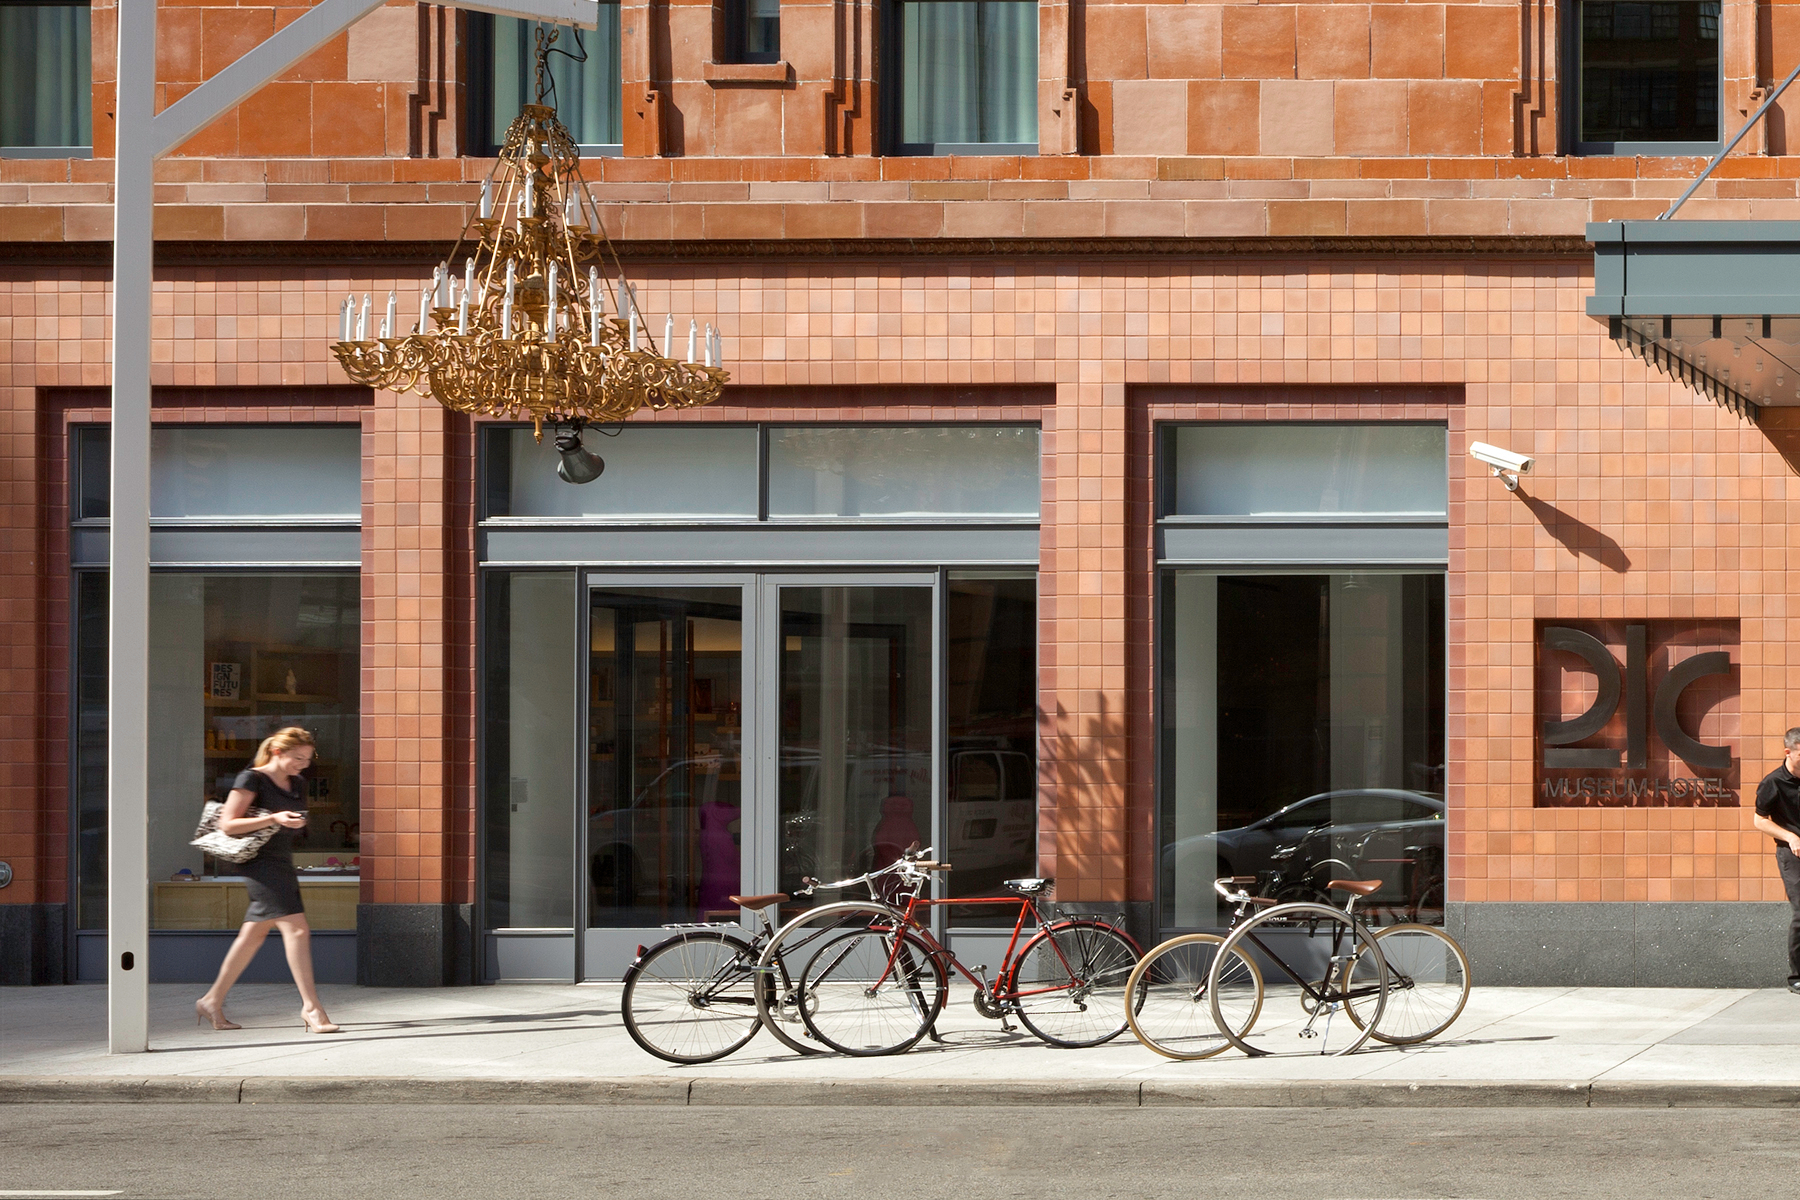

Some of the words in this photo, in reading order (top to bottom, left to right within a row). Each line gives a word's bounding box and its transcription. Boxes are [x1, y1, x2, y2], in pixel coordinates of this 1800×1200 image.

[213, 664, 233, 673] DES
[213, 672, 230, 681] IGN
[213, 680, 238, 689] FUTU
[213, 688, 232, 697] RES
[1544, 777, 1647, 799] MUSEUM
[1654, 777, 1732, 799] HOTEL
